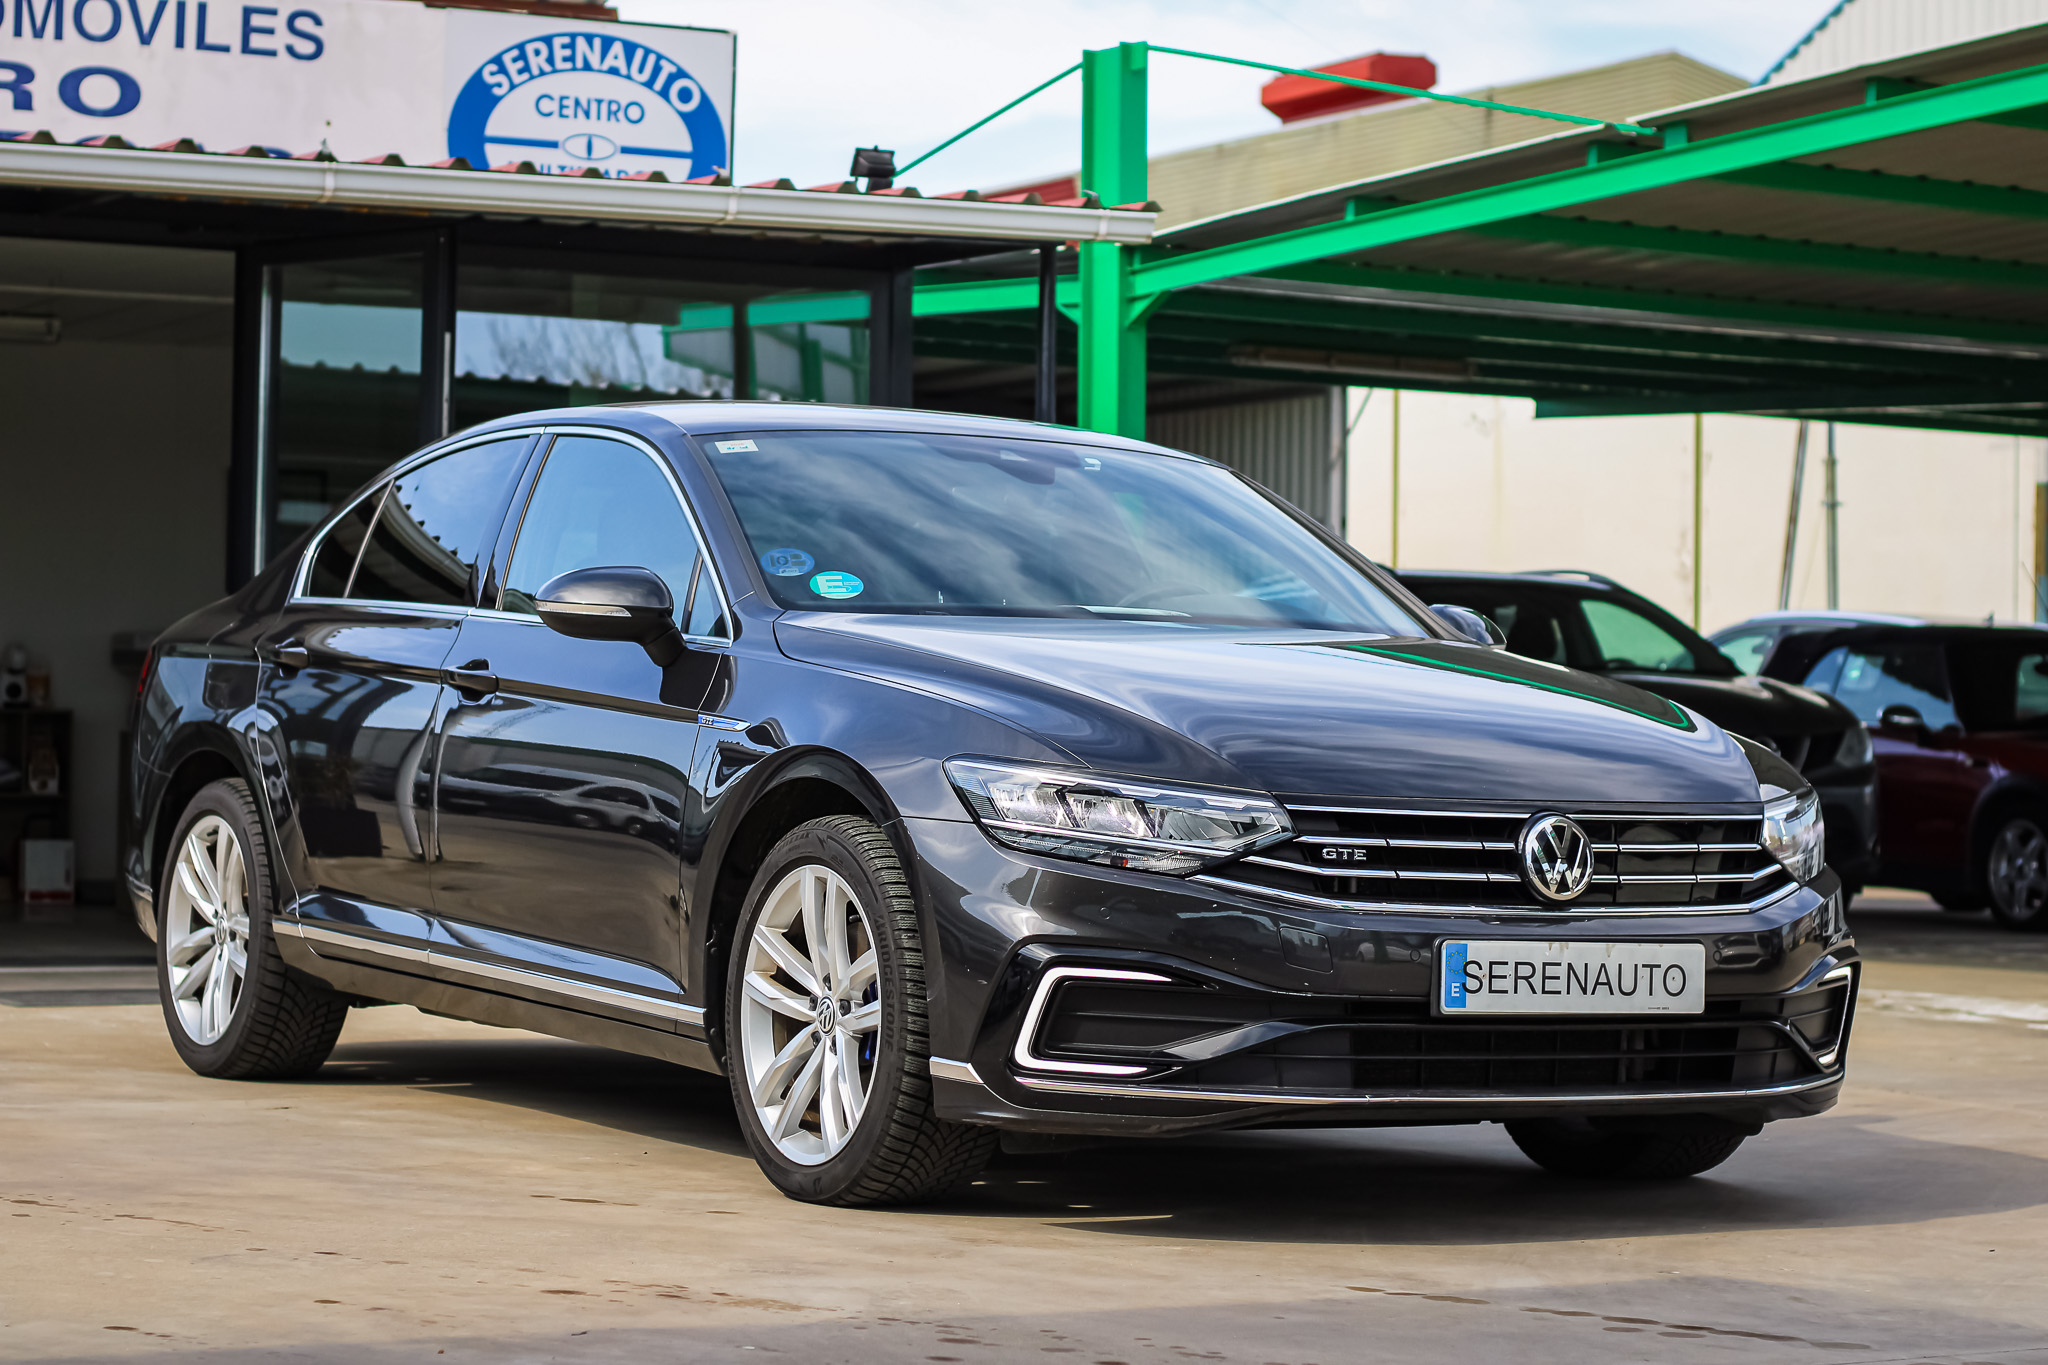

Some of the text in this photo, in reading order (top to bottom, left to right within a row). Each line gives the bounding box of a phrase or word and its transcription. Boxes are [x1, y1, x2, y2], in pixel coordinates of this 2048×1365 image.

[0, 0, 325, 61] MOVILES
[481, 35, 701, 113] SERENAUTO
[535, 94, 645, 124] CENTRO
[1321, 847, 1367, 860] GTE
[1451, 982, 1461, 997] E
